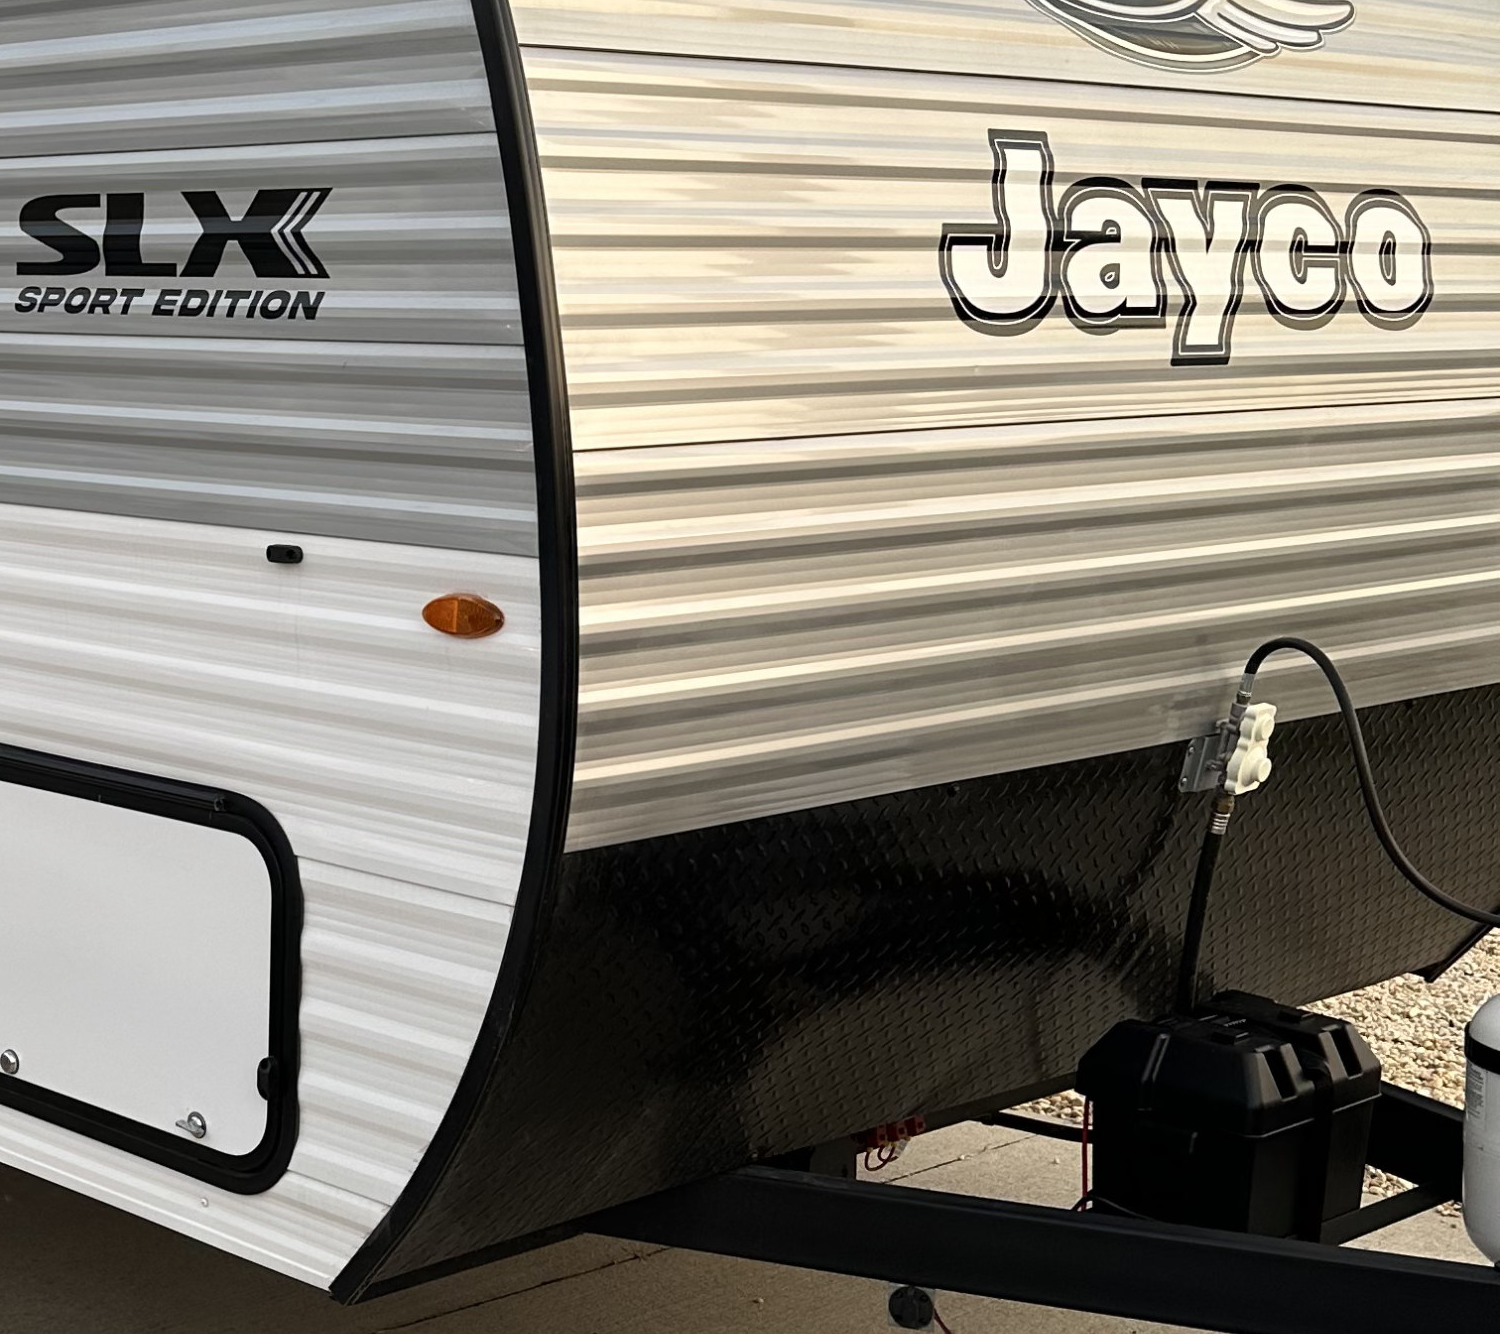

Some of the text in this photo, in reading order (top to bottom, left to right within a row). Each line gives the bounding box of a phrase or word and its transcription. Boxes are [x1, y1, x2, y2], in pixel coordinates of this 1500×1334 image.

[16, 187, 333, 279] SLX
[938, 128, 1434, 367] Jayco
[14, 286, 326, 320] SPORT EDITION
